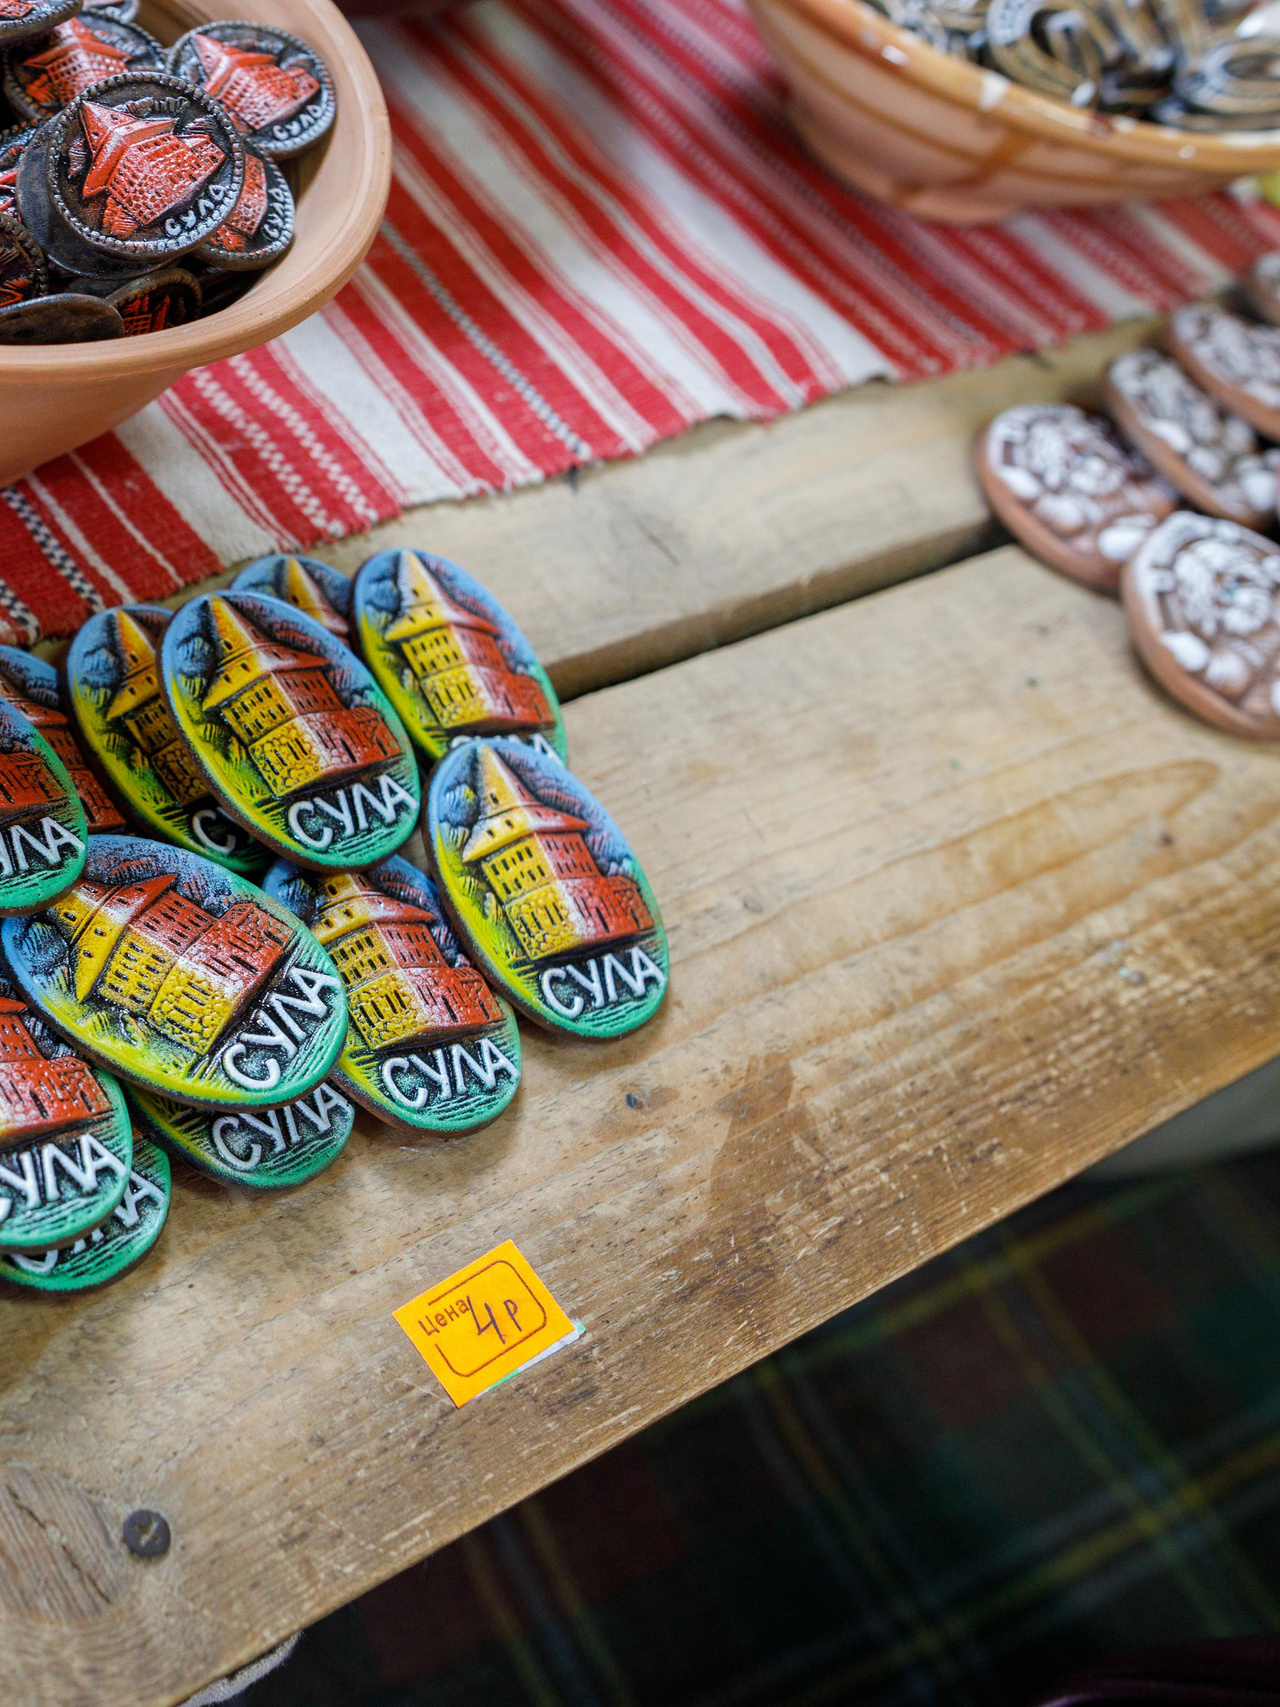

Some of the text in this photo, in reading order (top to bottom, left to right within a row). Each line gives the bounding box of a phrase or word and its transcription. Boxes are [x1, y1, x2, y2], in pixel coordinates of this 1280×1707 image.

[287, 773, 420, 849] СУЛА
[541, 946, 668, 1018] СУЛА
[223, 965, 340, 1090] СУЛА
[381, 1036, 520, 1109] СУЛА
[212, 1082, 356, 1169] СУЛА
[417, 1298, 471, 1337] Цена
